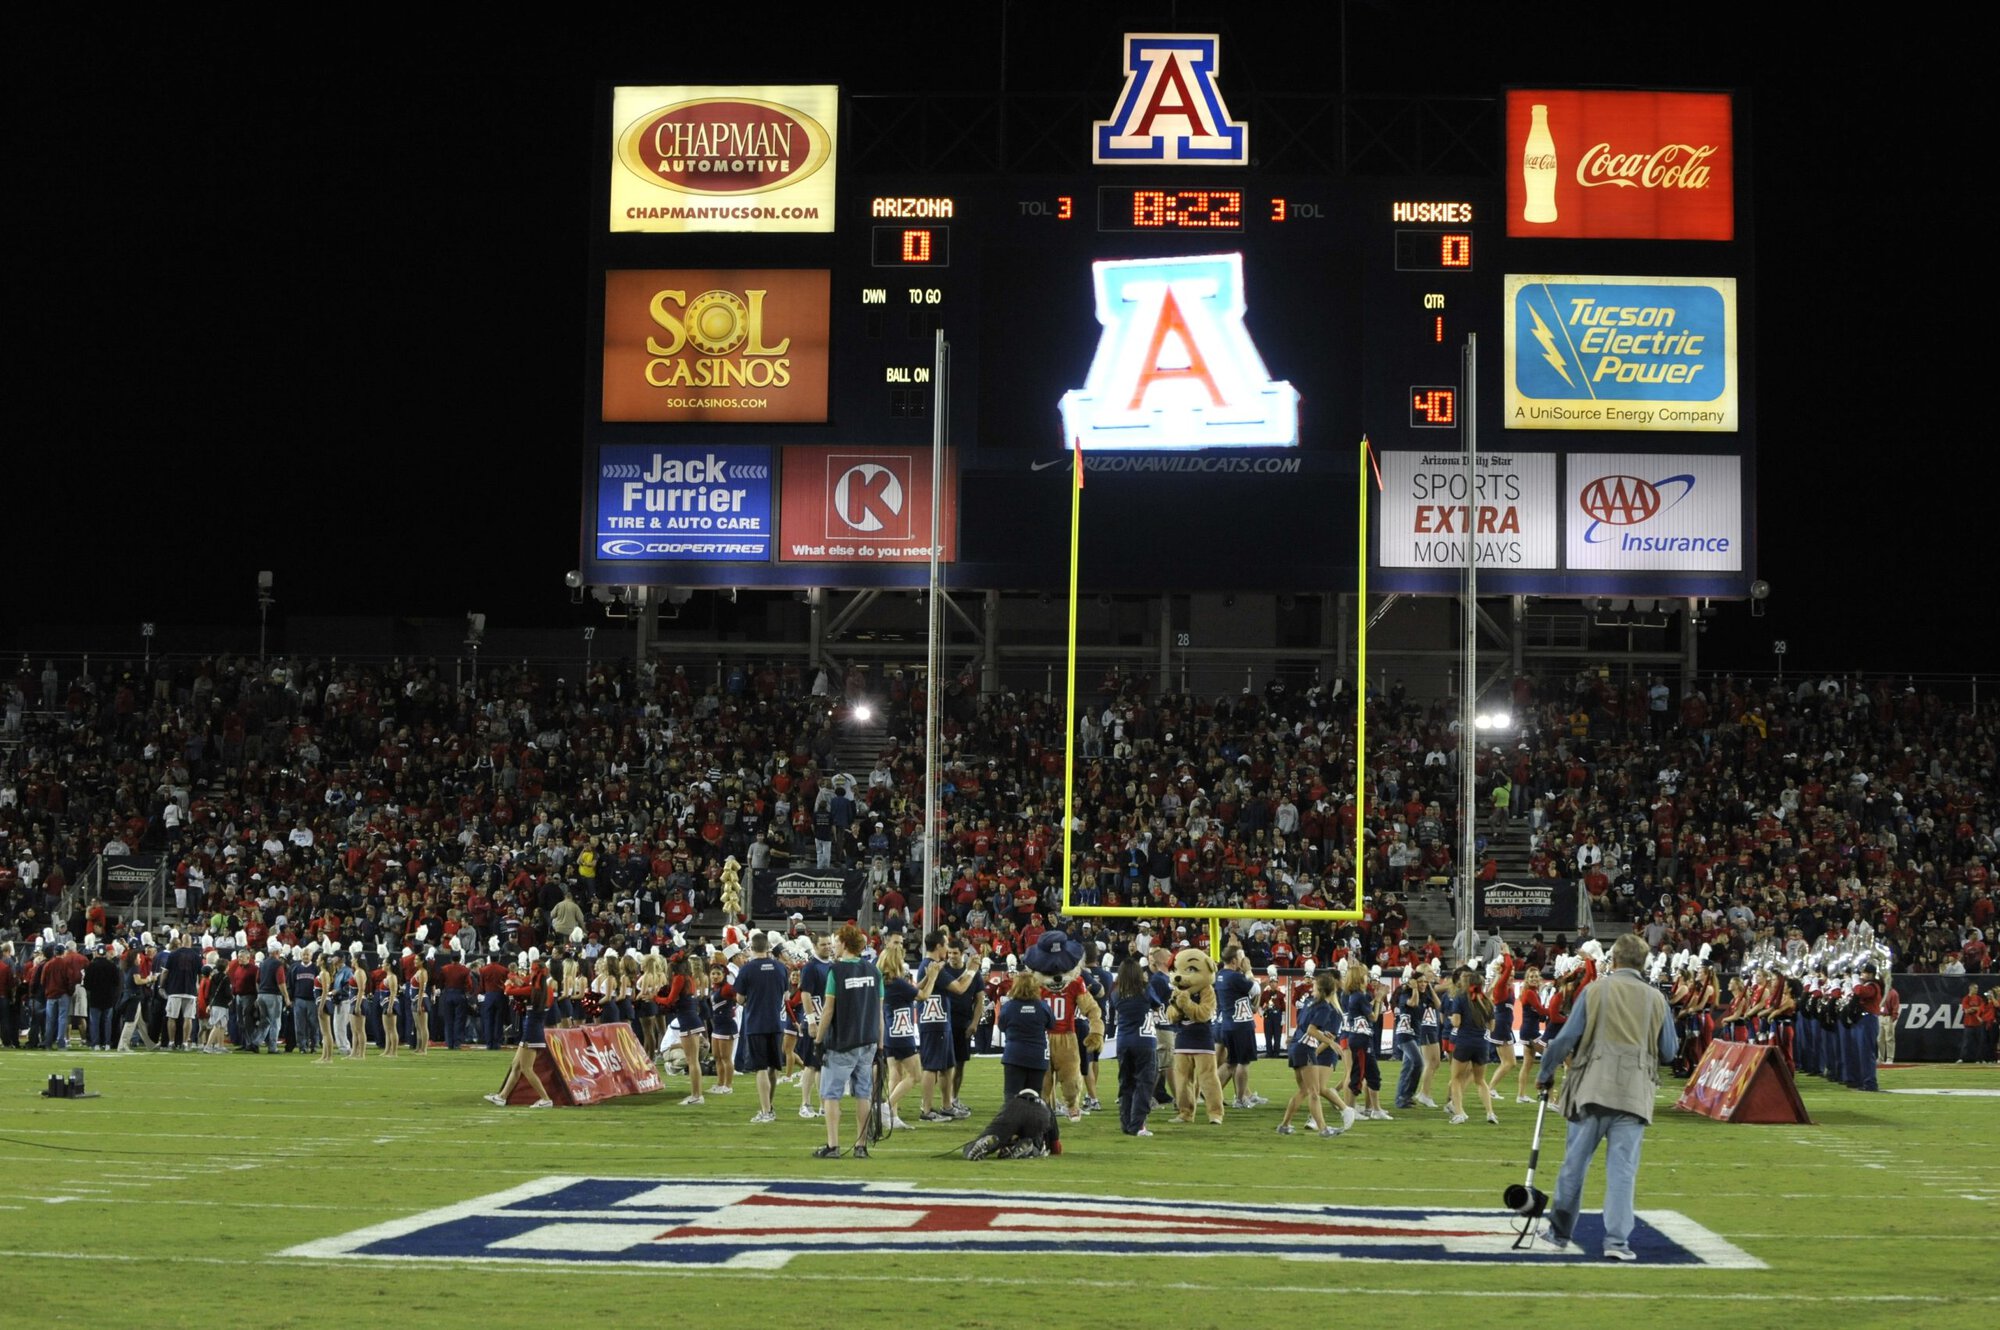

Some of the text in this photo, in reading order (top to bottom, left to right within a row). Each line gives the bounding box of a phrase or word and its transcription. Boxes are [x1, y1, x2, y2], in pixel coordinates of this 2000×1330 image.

[1092, 32, 1249, 164] A
[655, 122, 793, 158] CHAPMAN
[658, 159, 790, 173] AUTOMOTIVE
[1576, 143, 1719, 188] Coca-Cola
[626, 207, 819, 220] CHAPMANTUCSON.COM
[872, 198, 953, 218] ARIZONA
[1018, 196, 1072, 219] TOL 3
[1132, 190, 1240, 227] 8:22
[1271, 198, 1325, 221] 3 TOL
[1393, 202, 1472, 223] HUSKIES
[902, 229, 931, 262] 0
[1441, 235, 1470, 267] 0
[863, 289, 886, 304] DWN
[909, 289, 941, 304] TO GO
[1424, 294, 1445, 309] QTR
[646, 289, 790, 356] SOL
[1569, 298, 1676, 327] Tucson
[1579, 328, 1704, 355] Electric
[644, 358, 790, 388] CASINOS
[886, 367, 929, 382] BALL ON
[1592, 356, 1704, 384] Power
[667, 398, 767, 409] SOLCASINOS.COM
[1414, 391, 1452, 423] 40
[1515, 407, 1724, 424] A UniSource Energy Company
[643, 453, 727, 484] Jack
[1420, 455, 1513, 468] Arizona Dily Star
[623, 482, 746, 513] Furrier
[839, 464, 902, 531] K
[1412, 473, 1520, 500] SPORTS
[1584, 476, 1655, 524] AAA
[608, 517, 760, 530] TIRE & AUTO CARE
[1414, 505, 1520, 534] EXTRA
[792, 545, 825, 556] What
[829, 545, 855, 556] else
[858, 545, 875, 556] do
[878, 546, 900, 558] you
[1621, 532, 1730, 553] Insurance
[584, 627, 595, 640] 27
[1178, 633, 1190, 646] 28
[1774, 640, 1786, 654] 29
[817, 881, 844, 889] FAMILY
[1485, 890, 1552, 898] AMERICAN FAMILY
[845, 976, 875, 989] ESPN
[920, 995, 947, 1023] A
